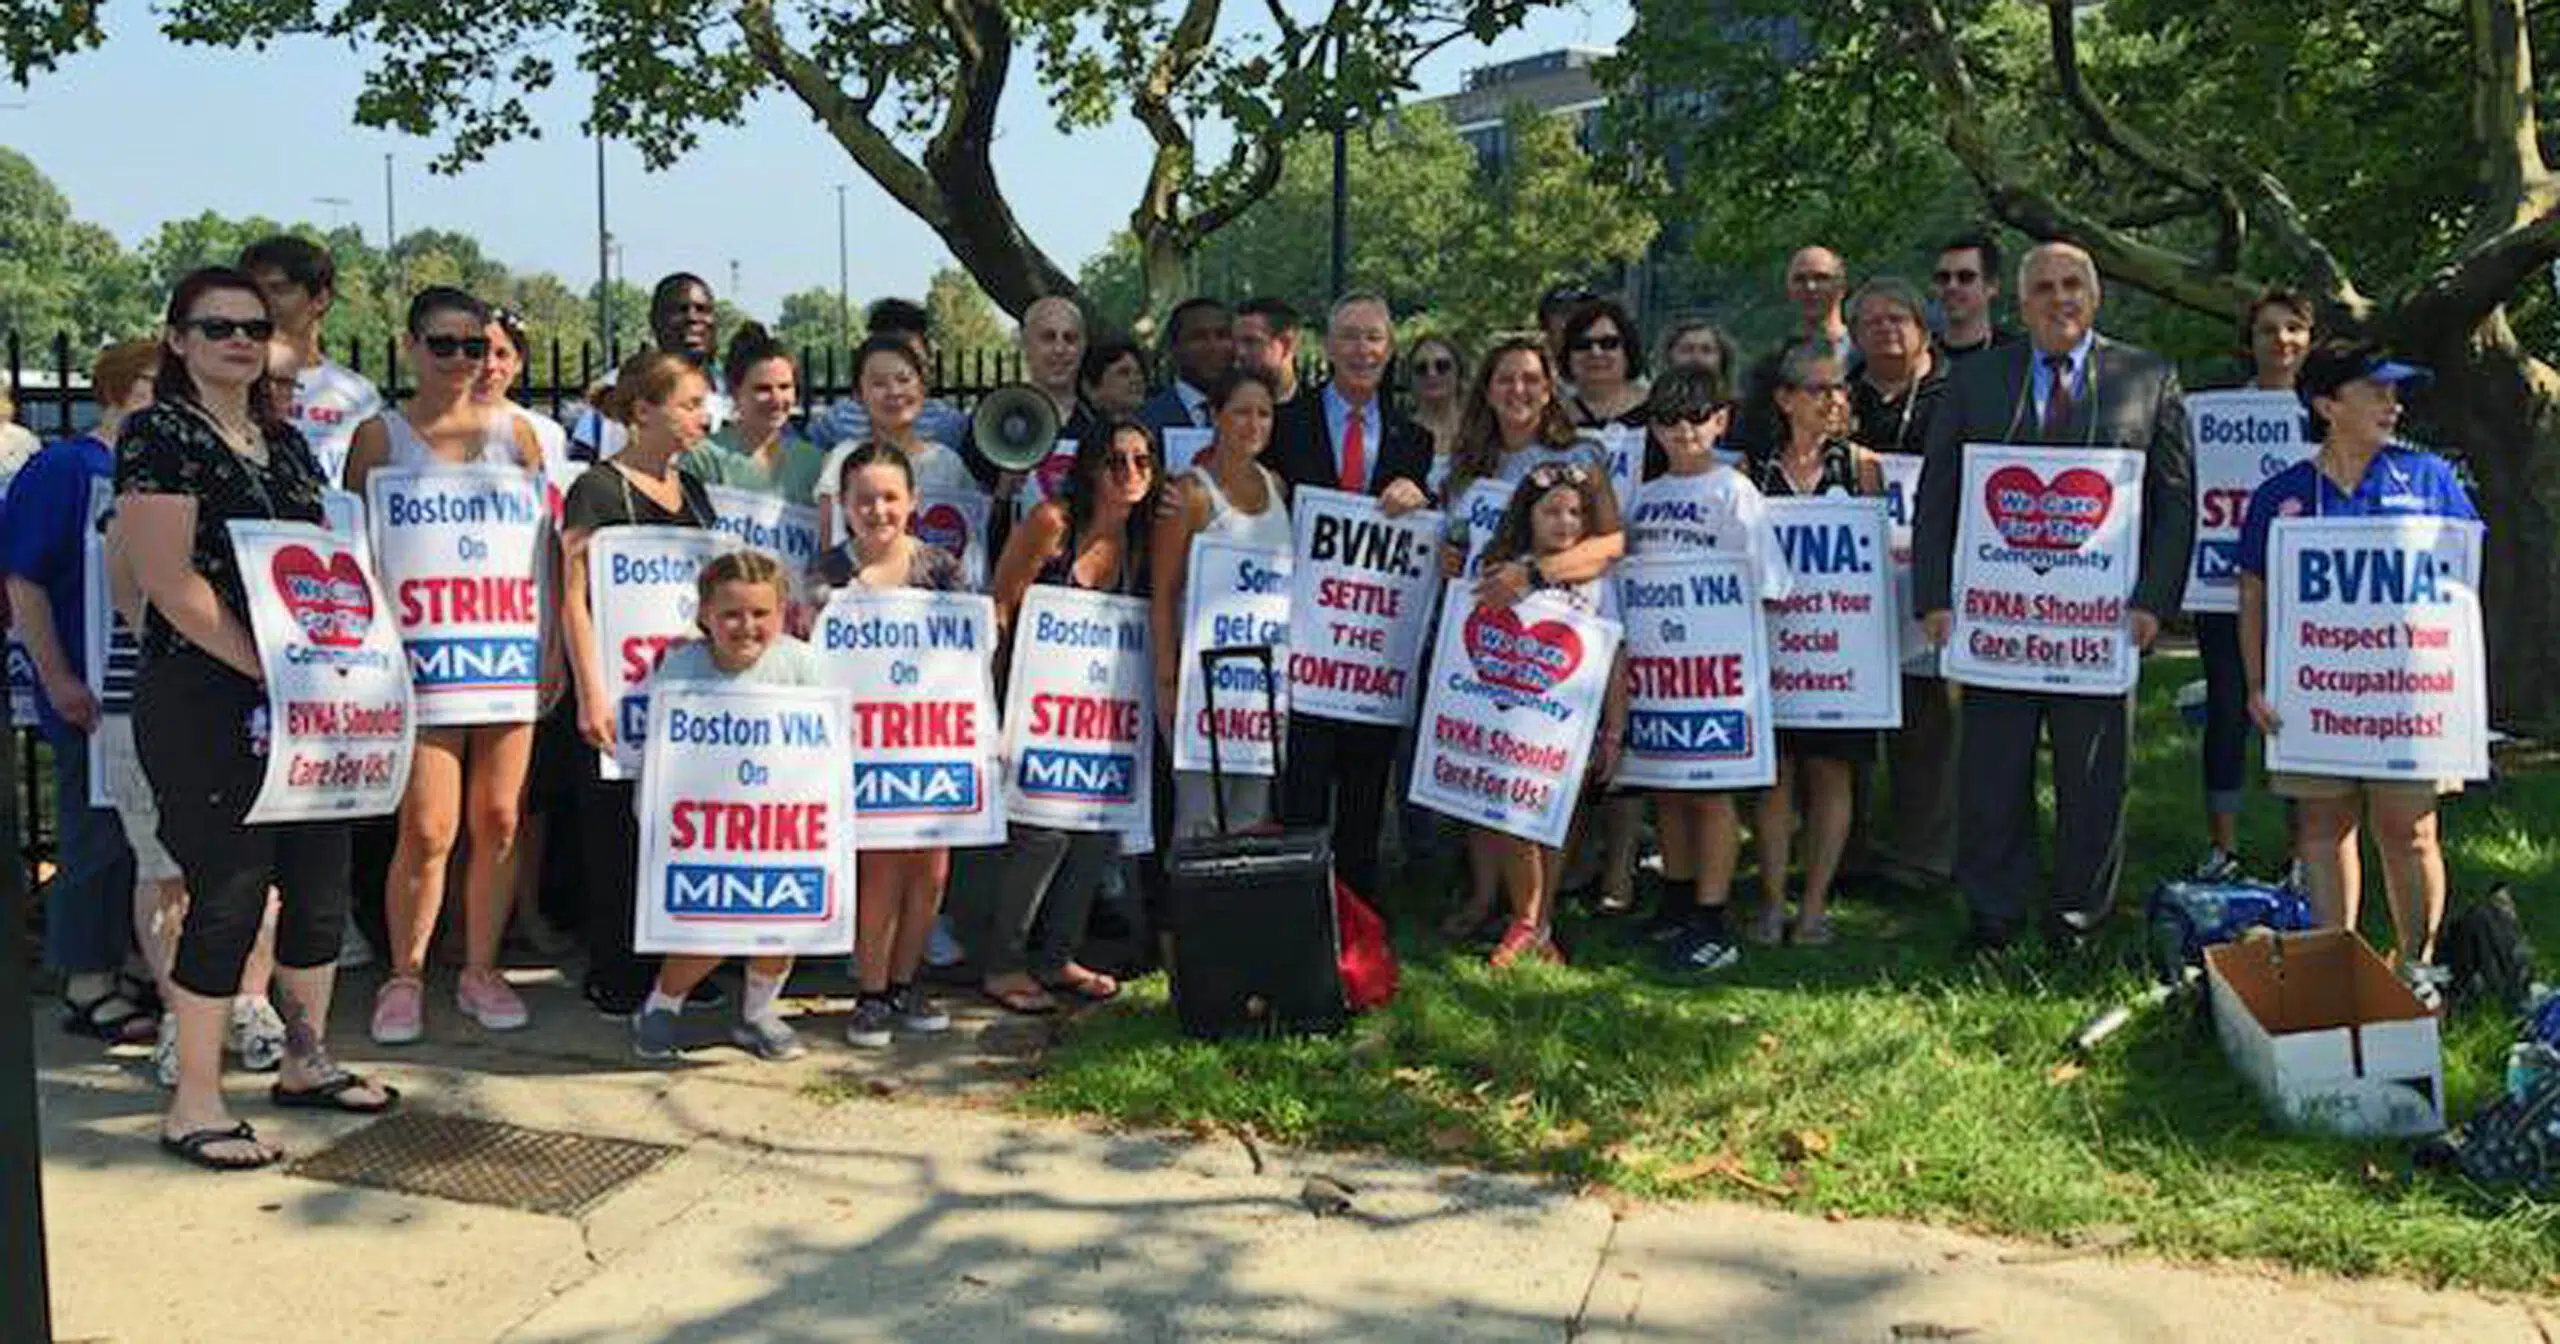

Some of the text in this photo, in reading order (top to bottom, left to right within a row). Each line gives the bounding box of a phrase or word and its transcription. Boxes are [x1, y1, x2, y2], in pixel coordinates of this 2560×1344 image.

[2201, 413, 2290, 444] Boston
[388, 491, 486, 526] Boston
[458, 535, 488, 560] On
[715, 514, 781, 550] oston
[1310, 514, 1429, 579] BVNA:
[1773, 524, 1873, 574] VNA:
[1978, 543, 2112, 571] Community
[1690, 574, 1743, 606] VNA
[2299, 548, 2451, 605] BVNA:
[399, 576, 536, 626] STRIKE
[1317, 578, 1401, 619] SETTLE
[1965, 587, 2119, 623] BVNA Should
[826, 613, 976, 650] Boston VNA
[1036, 611, 1113, 648] Boston
[1213, 612, 1253, 646] get
[1329, 622, 1384, 652] THE
[1659, 618, 1687, 643] On
[1777, 628, 1840, 653] Social
[1969, 628, 2109, 663] Care For Us!
[2300, 620, 2450, 652] Respect Your
[412, 643, 528, 680] MNA
[888, 660, 919, 686] On
[1287, 653, 1406, 698] CONTRACT
[1625, 654, 1744, 700] STRIKE
[2298, 664, 2455, 697] Occupational
[669, 708, 771, 746] Boston
[779, 711, 828, 745] VNA
[854, 701, 976, 748] TRIKE
[1028, 693, 1140, 742] STRIKE
[1630, 712, 1731, 748] MNA
[2309, 708, 2445, 741] Therapists!
[1488, 729, 1567, 772] Should
[737, 759, 769, 787] On
[1025, 754, 1125, 789] MNA
[670, 800, 828, 852] STRIKE
[673, 871, 809, 909] MNA
